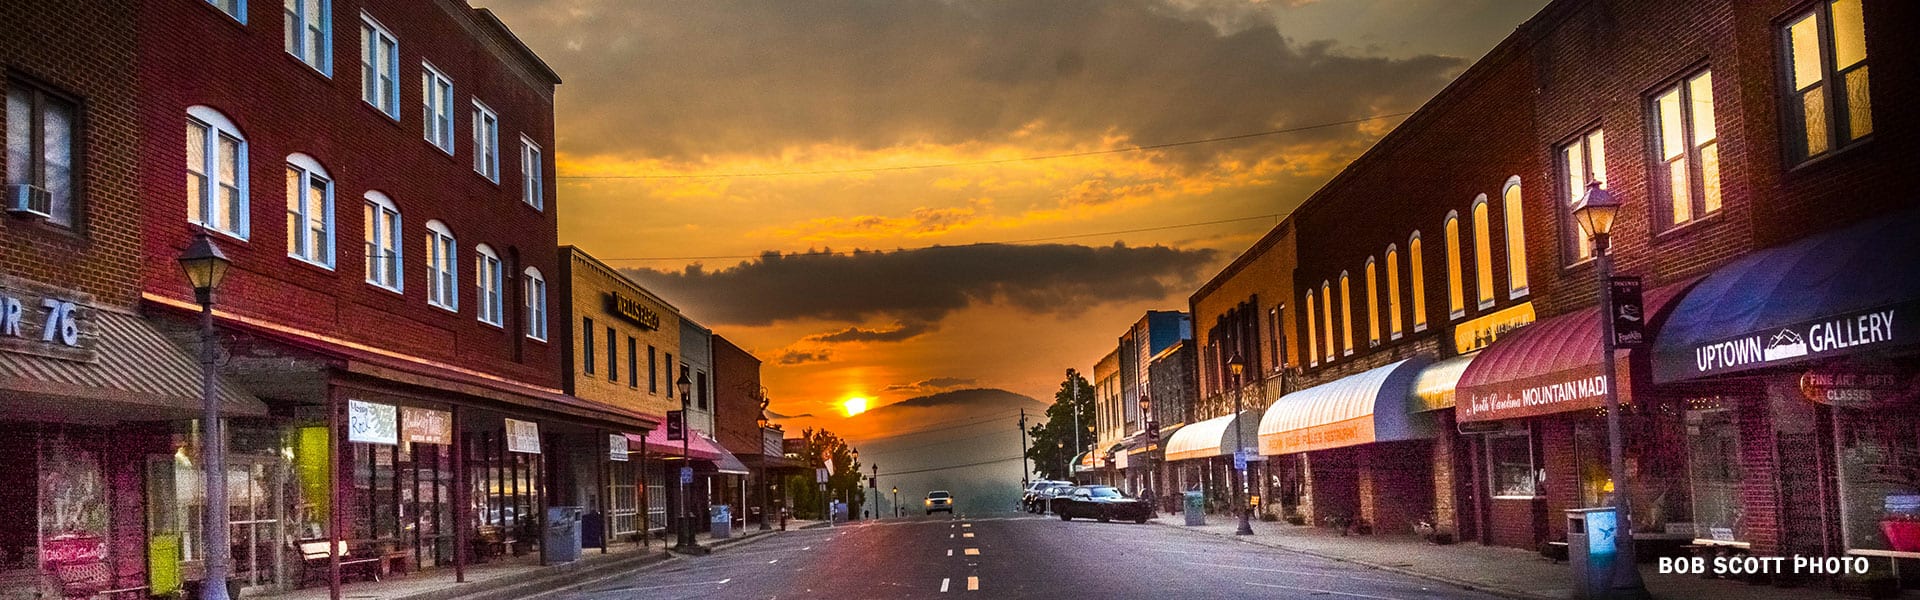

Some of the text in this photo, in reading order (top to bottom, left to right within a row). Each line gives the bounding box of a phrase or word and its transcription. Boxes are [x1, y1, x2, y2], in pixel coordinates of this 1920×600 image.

[0, 296, 78, 346] R 76
[1696, 310, 1895, 372] UPTOWN GALLERY
[1810, 374, 1894, 386] FINE ART GIFTS
[1827, 389, 1872, 400] CLASSES
[1466, 393, 1489, 416] North
[1490, 393, 1521, 413] Carolina
[1522, 381, 1577, 407] MOUNTAIN
